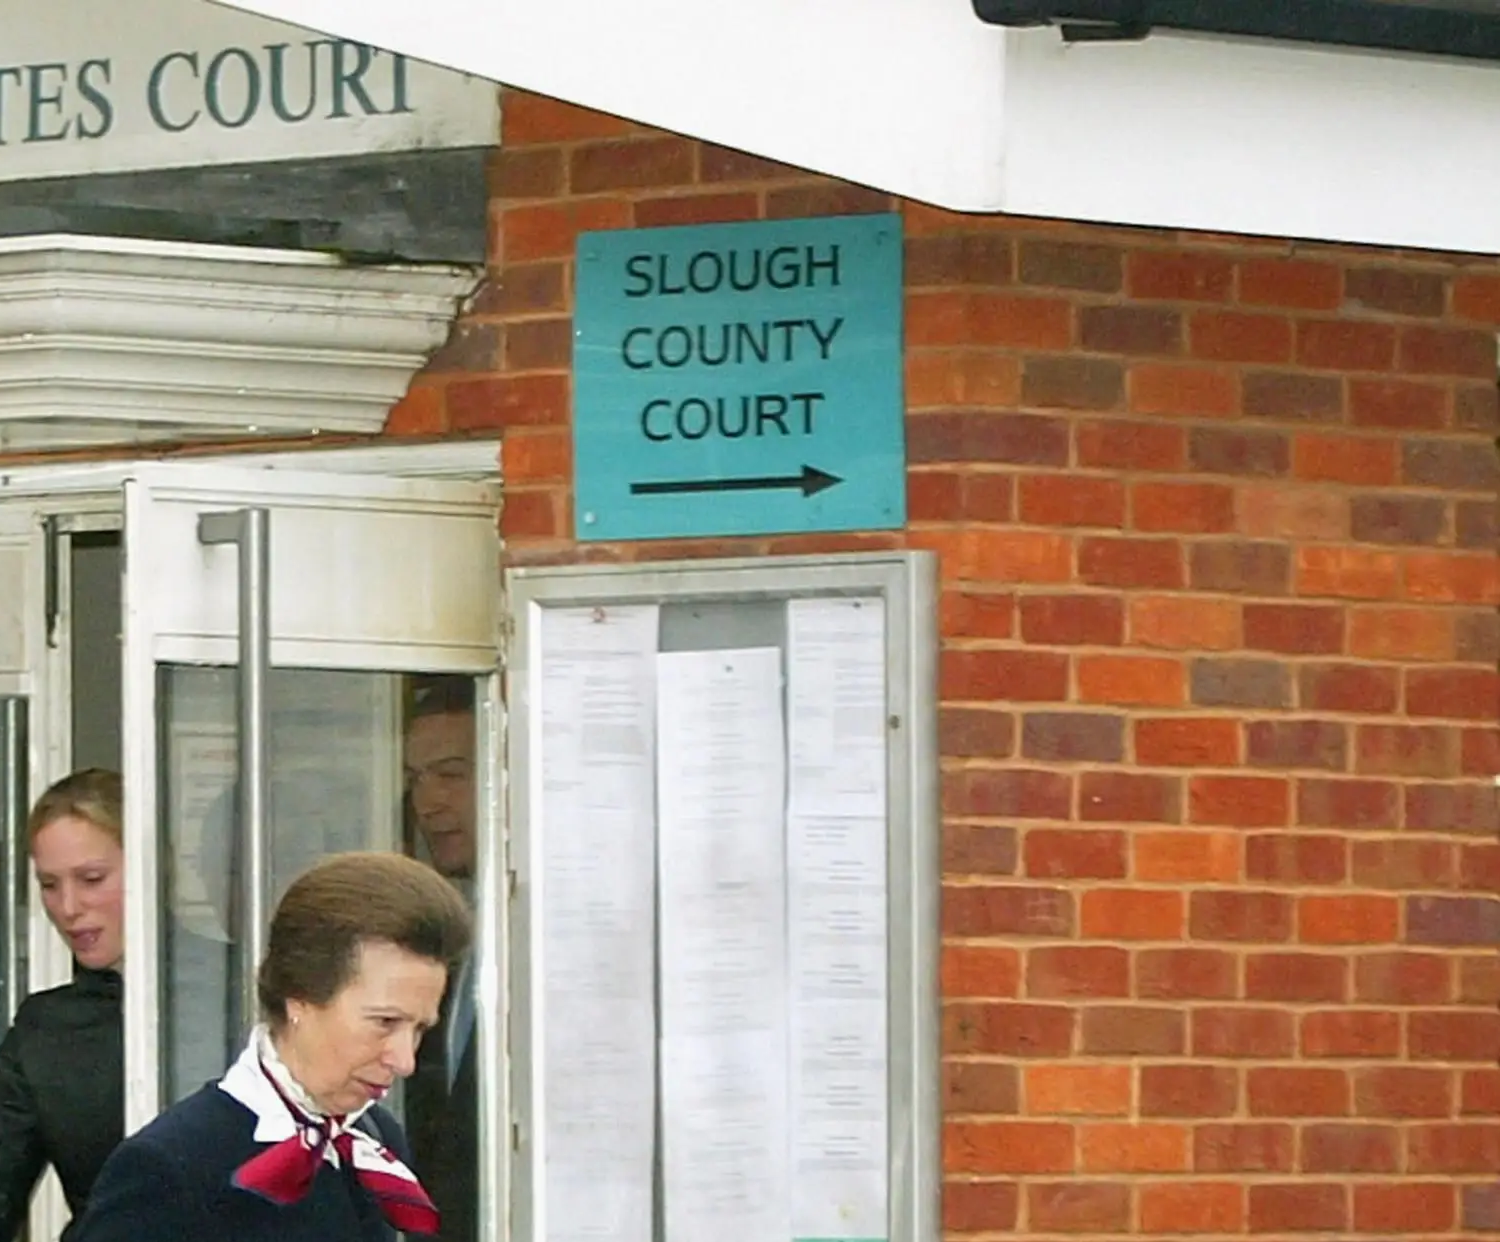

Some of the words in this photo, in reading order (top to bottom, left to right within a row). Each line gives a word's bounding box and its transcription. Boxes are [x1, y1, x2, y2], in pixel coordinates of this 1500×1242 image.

[147, 38, 415, 132] COURT
[623, 244, 842, 298] SLOUGH
[622, 317, 845, 371] COUNTY
[641, 392, 826, 442] COURT
